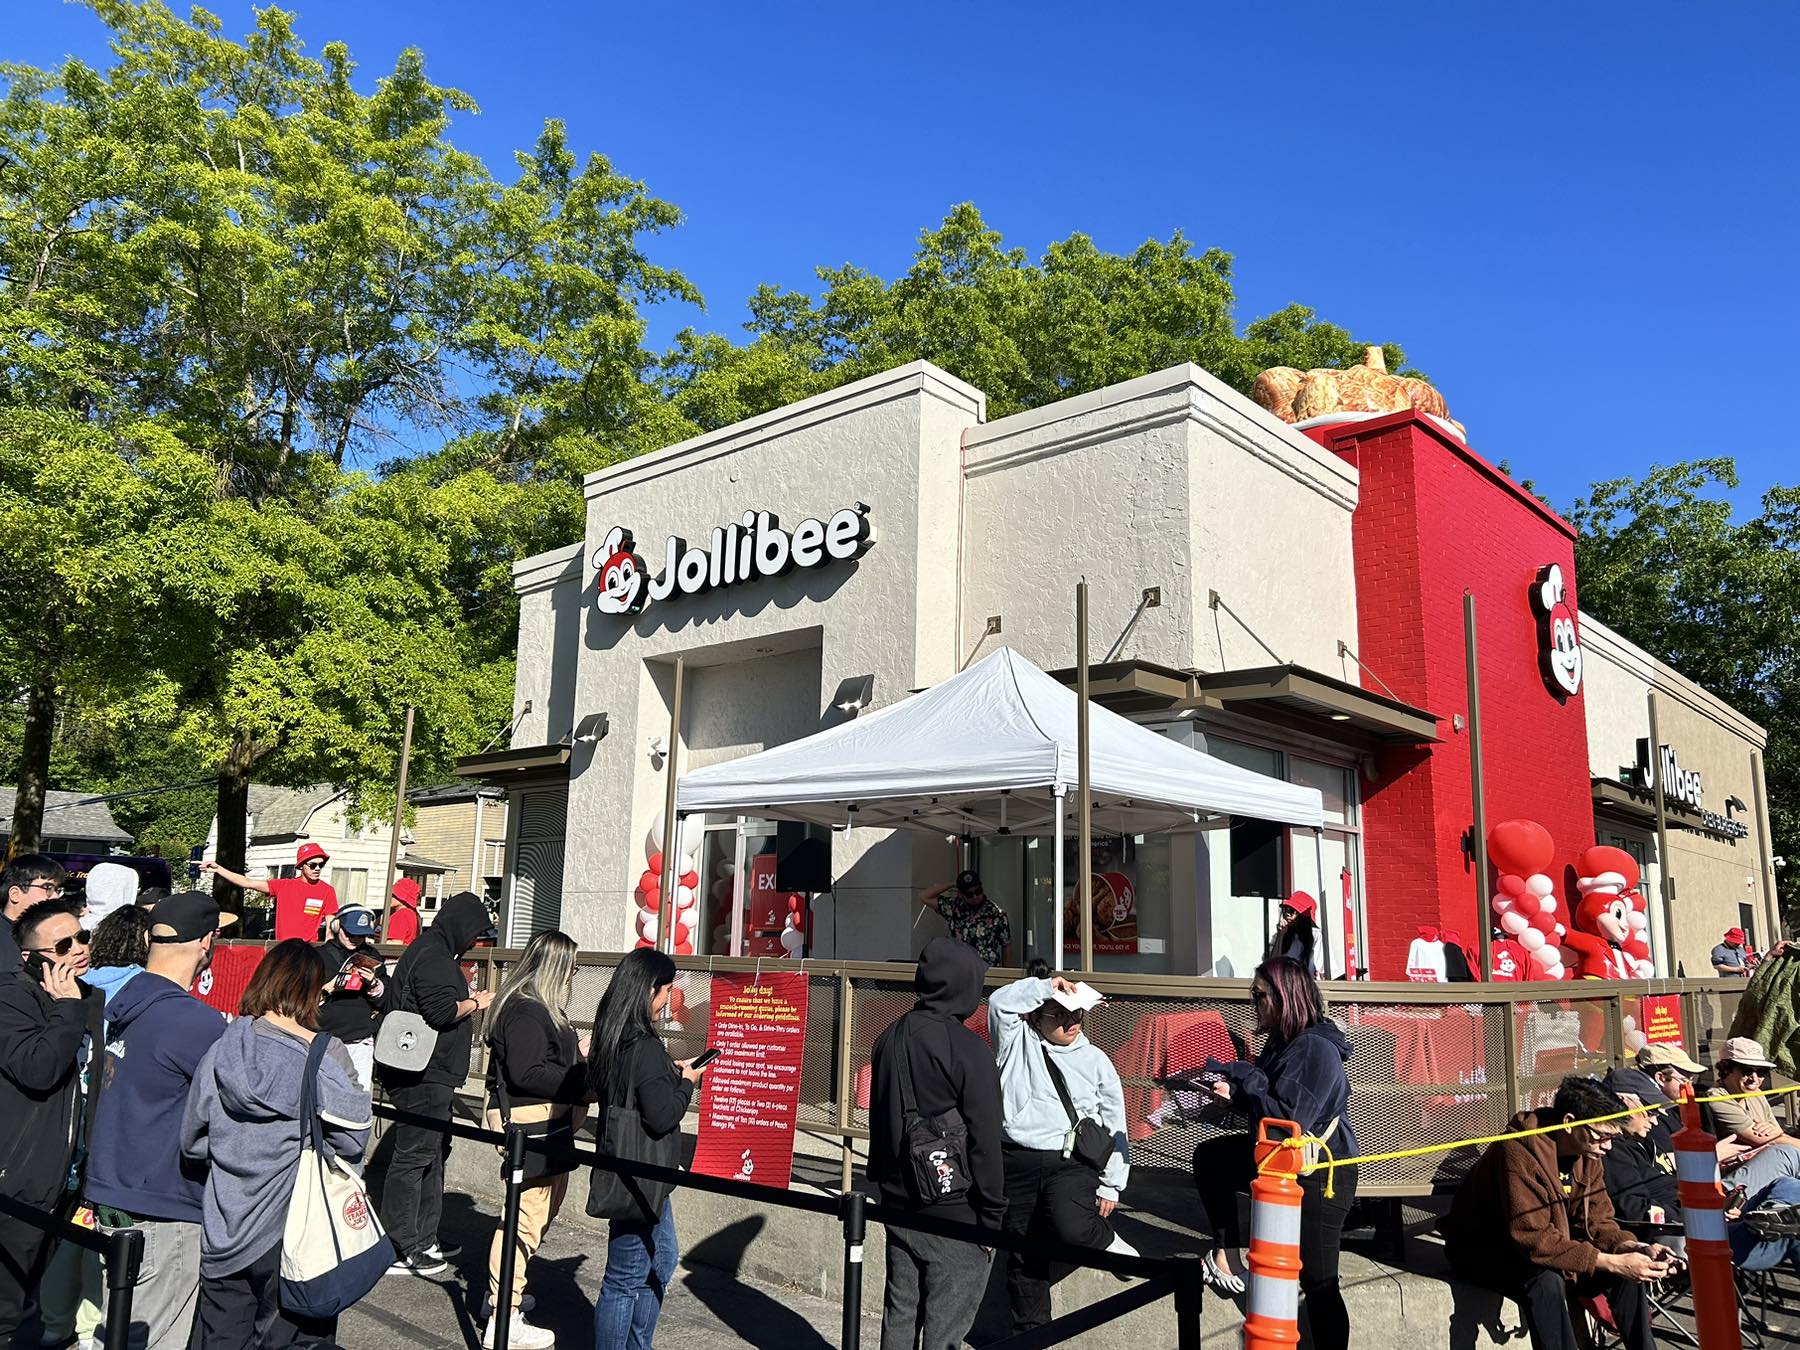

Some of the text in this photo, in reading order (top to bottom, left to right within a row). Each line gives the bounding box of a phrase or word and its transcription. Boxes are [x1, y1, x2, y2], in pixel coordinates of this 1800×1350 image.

[648, 508, 862, 602] Jollibee
[1644, 737, 1702, 808] Jllibee
[766, 1044, 786, 1052] customer
[720, 1058, 732, 1066] avoid
[774, 1065, 796, 1074] encourage
[711, 1084, 723, 1092] order
[730, 1078, 752, 1086] maximum
[769, 1083, 786, 1092] quantity
[713, 1103, 730, 1112] buckets
[737, 1098, 751, 1106] pieces
[712, 1112, 734, 1121] Maximum
[756, 1118, 769, 1126] orders
[775, 1121, 788, 1129] Peach
[712, 1120, 728, 1130] Mango
